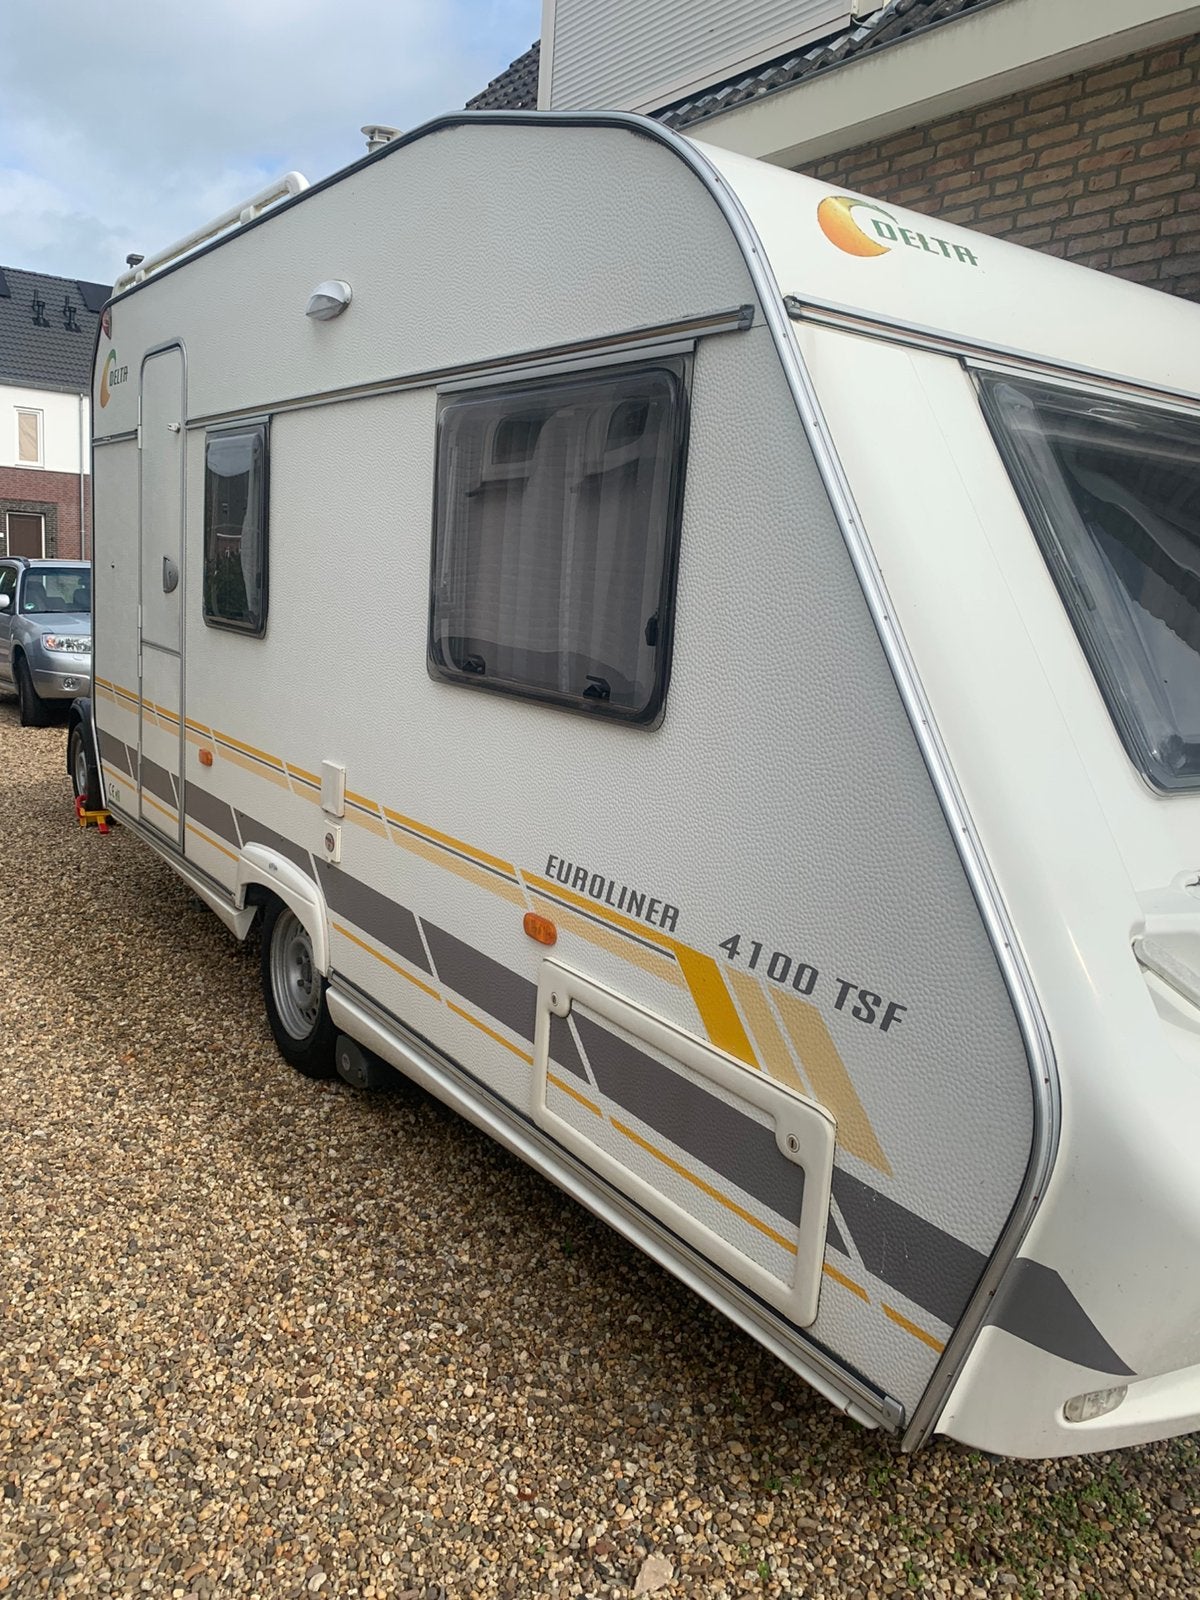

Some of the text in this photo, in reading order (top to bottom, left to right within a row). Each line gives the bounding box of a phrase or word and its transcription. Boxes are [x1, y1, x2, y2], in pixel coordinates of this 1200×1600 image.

[871, 219, 978, 266] DELTA
[109, 366, 128, 386] DELTA
[545, 854, 680, 932] EUROLINER
[718, 934, 908, 1032] 4100 TSF
